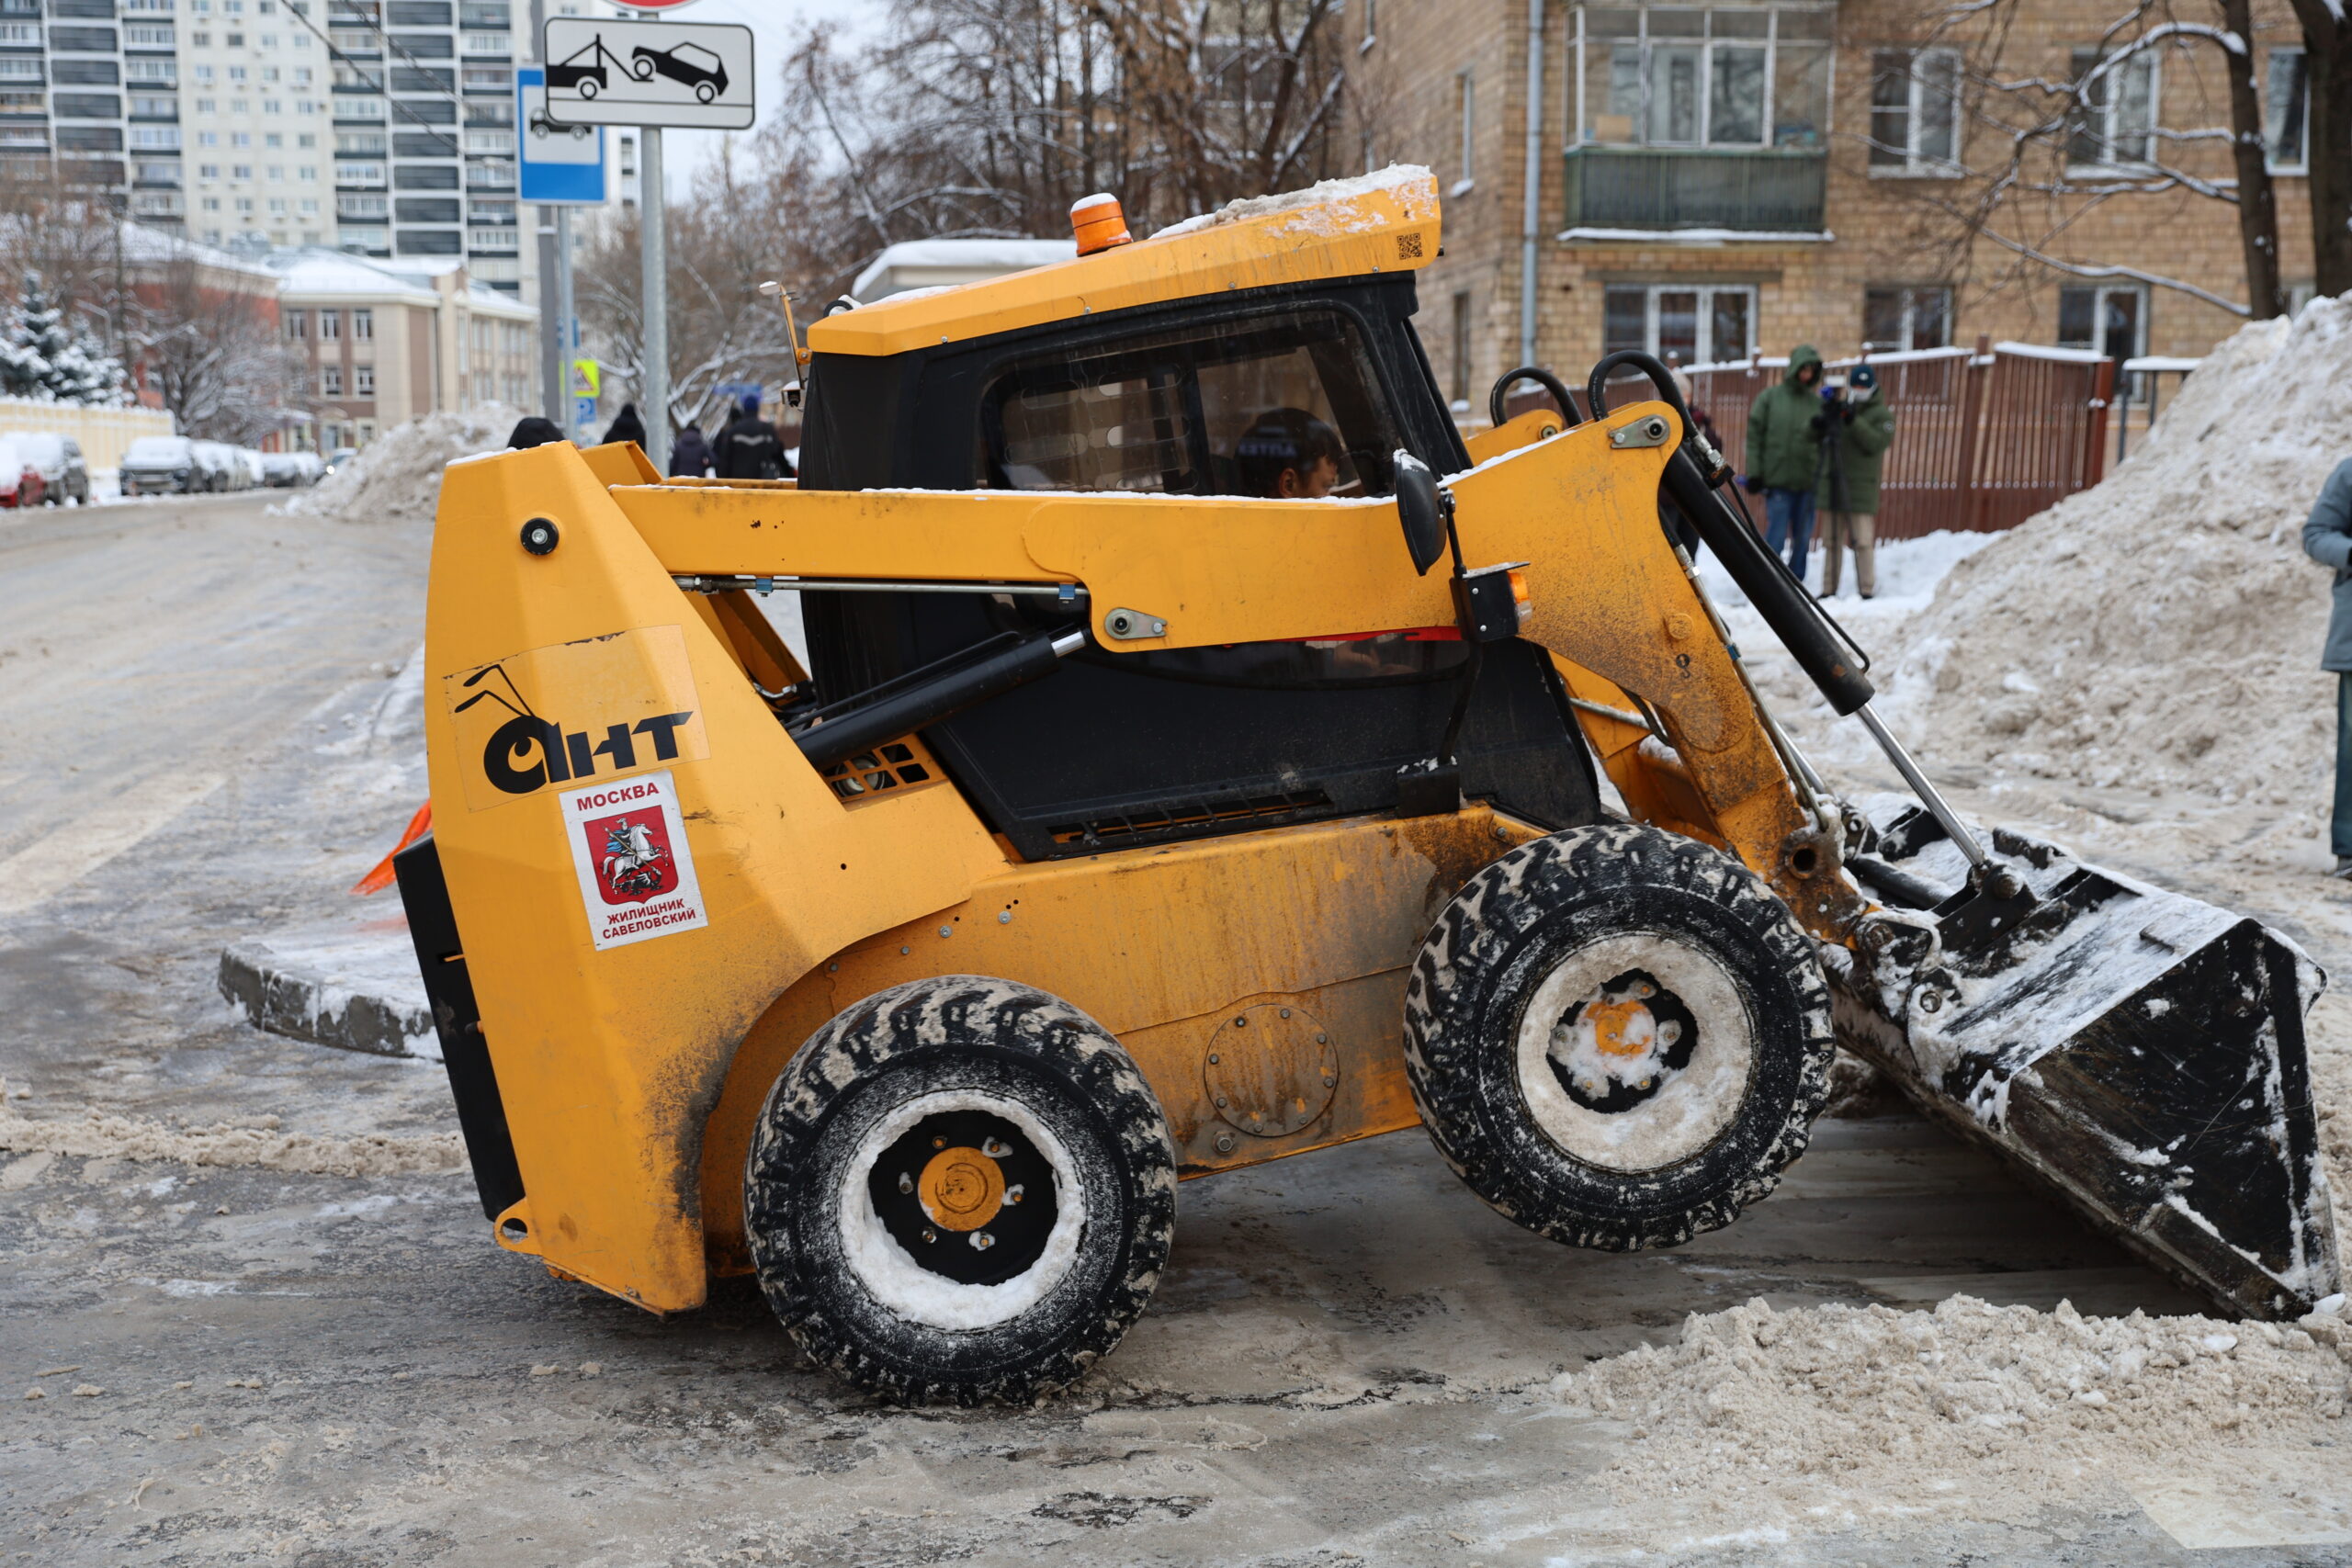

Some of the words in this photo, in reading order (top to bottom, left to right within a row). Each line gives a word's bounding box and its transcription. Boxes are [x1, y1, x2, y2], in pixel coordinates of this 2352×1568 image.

[576, 782, 660, 811] МОСКВА
[602, 907, 696, 940] САВЕЛОВСКИЙ
[606, 897, 685, 925] ЖИЛИЩНИК
